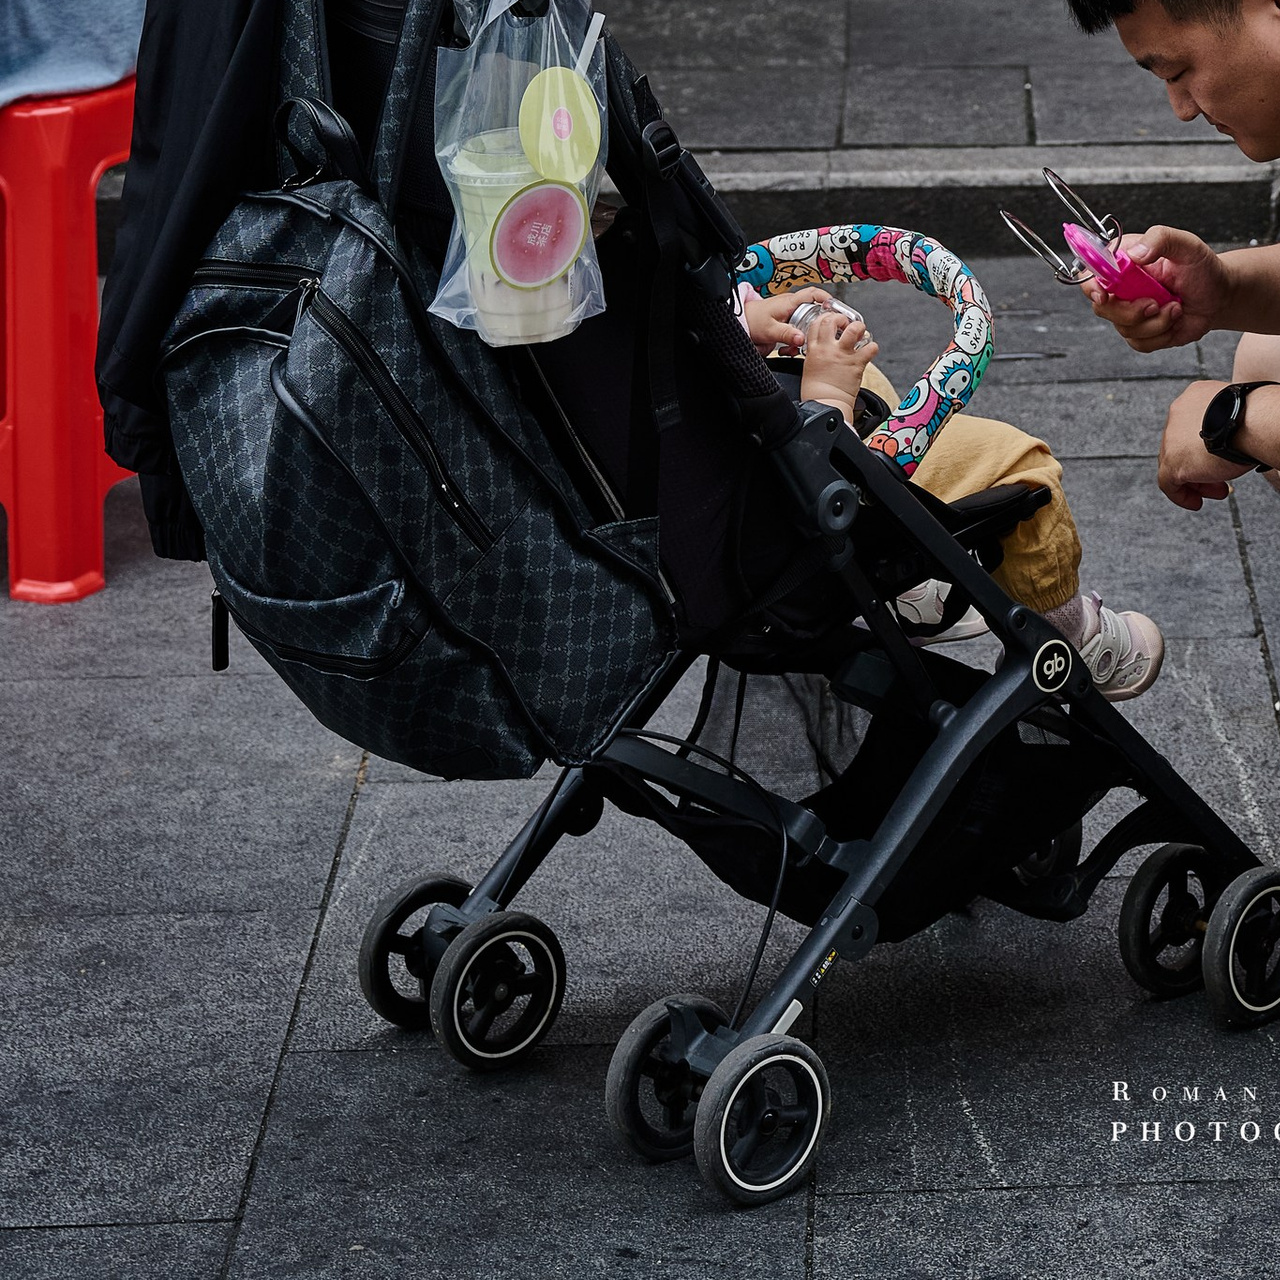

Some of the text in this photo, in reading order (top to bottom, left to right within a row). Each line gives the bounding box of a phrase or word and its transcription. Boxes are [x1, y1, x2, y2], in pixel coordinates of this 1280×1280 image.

[781, 241, 805, 253] ROY
[961, 315, 974, 337] ROY
[1043, 652, 1066, 680] gb
